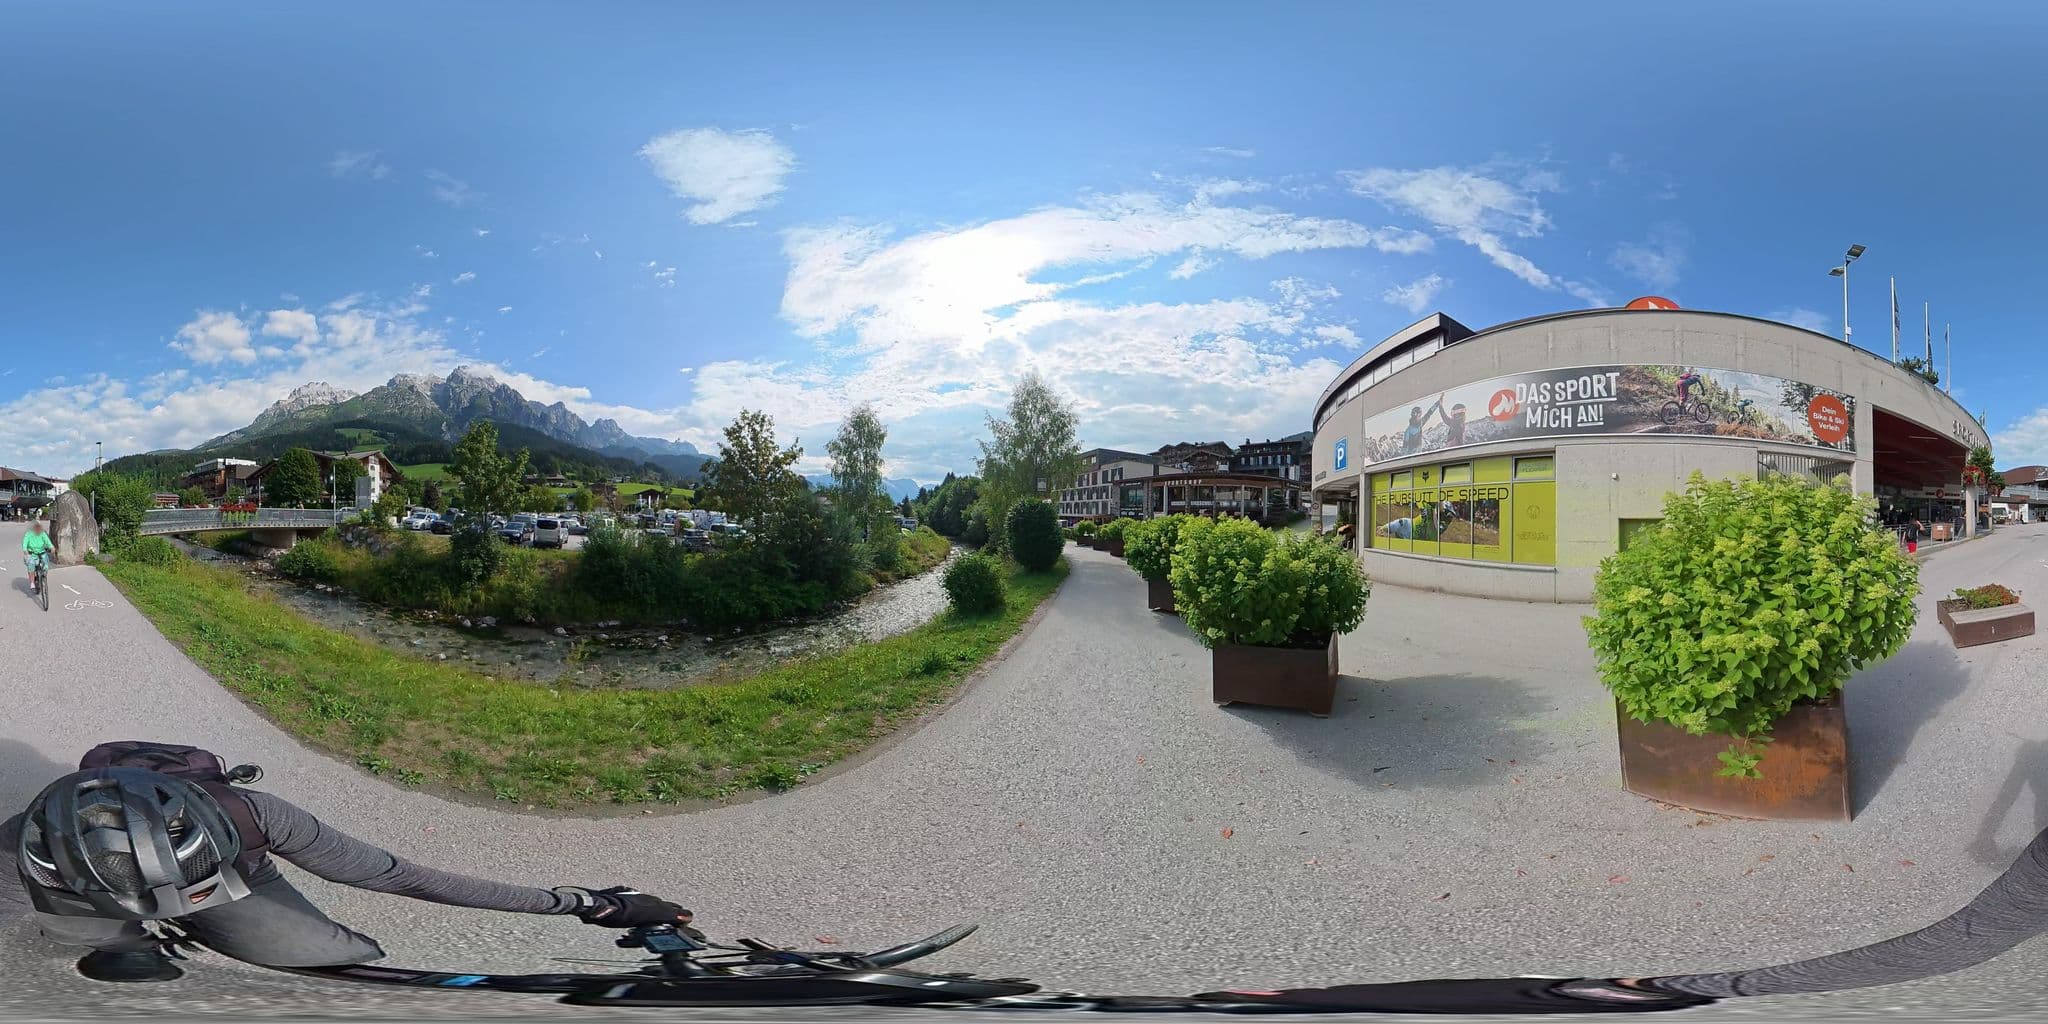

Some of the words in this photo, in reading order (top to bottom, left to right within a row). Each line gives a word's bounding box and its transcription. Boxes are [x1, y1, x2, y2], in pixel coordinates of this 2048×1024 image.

[1516, 383, 1551, 404] DAS
[1555, 372, 1620, 402] SPORT
[1577, 404, 1604, 422] AN!
[1813, 412, 1828, 422] Bike
[1834, 417, 1845, 425] Ski
[1822, 406, 1836, 415] Dein
[1819, 422, 1840, 432] Verleih
[1337, 447, 1345, 468] P
[1373, 495, 1387, 505] THE
[1389, 491, 1433, 504] PURSUIT
[1439, 490, 1454, 502] OF
[1460, 487, 1509, 501] SPEED
